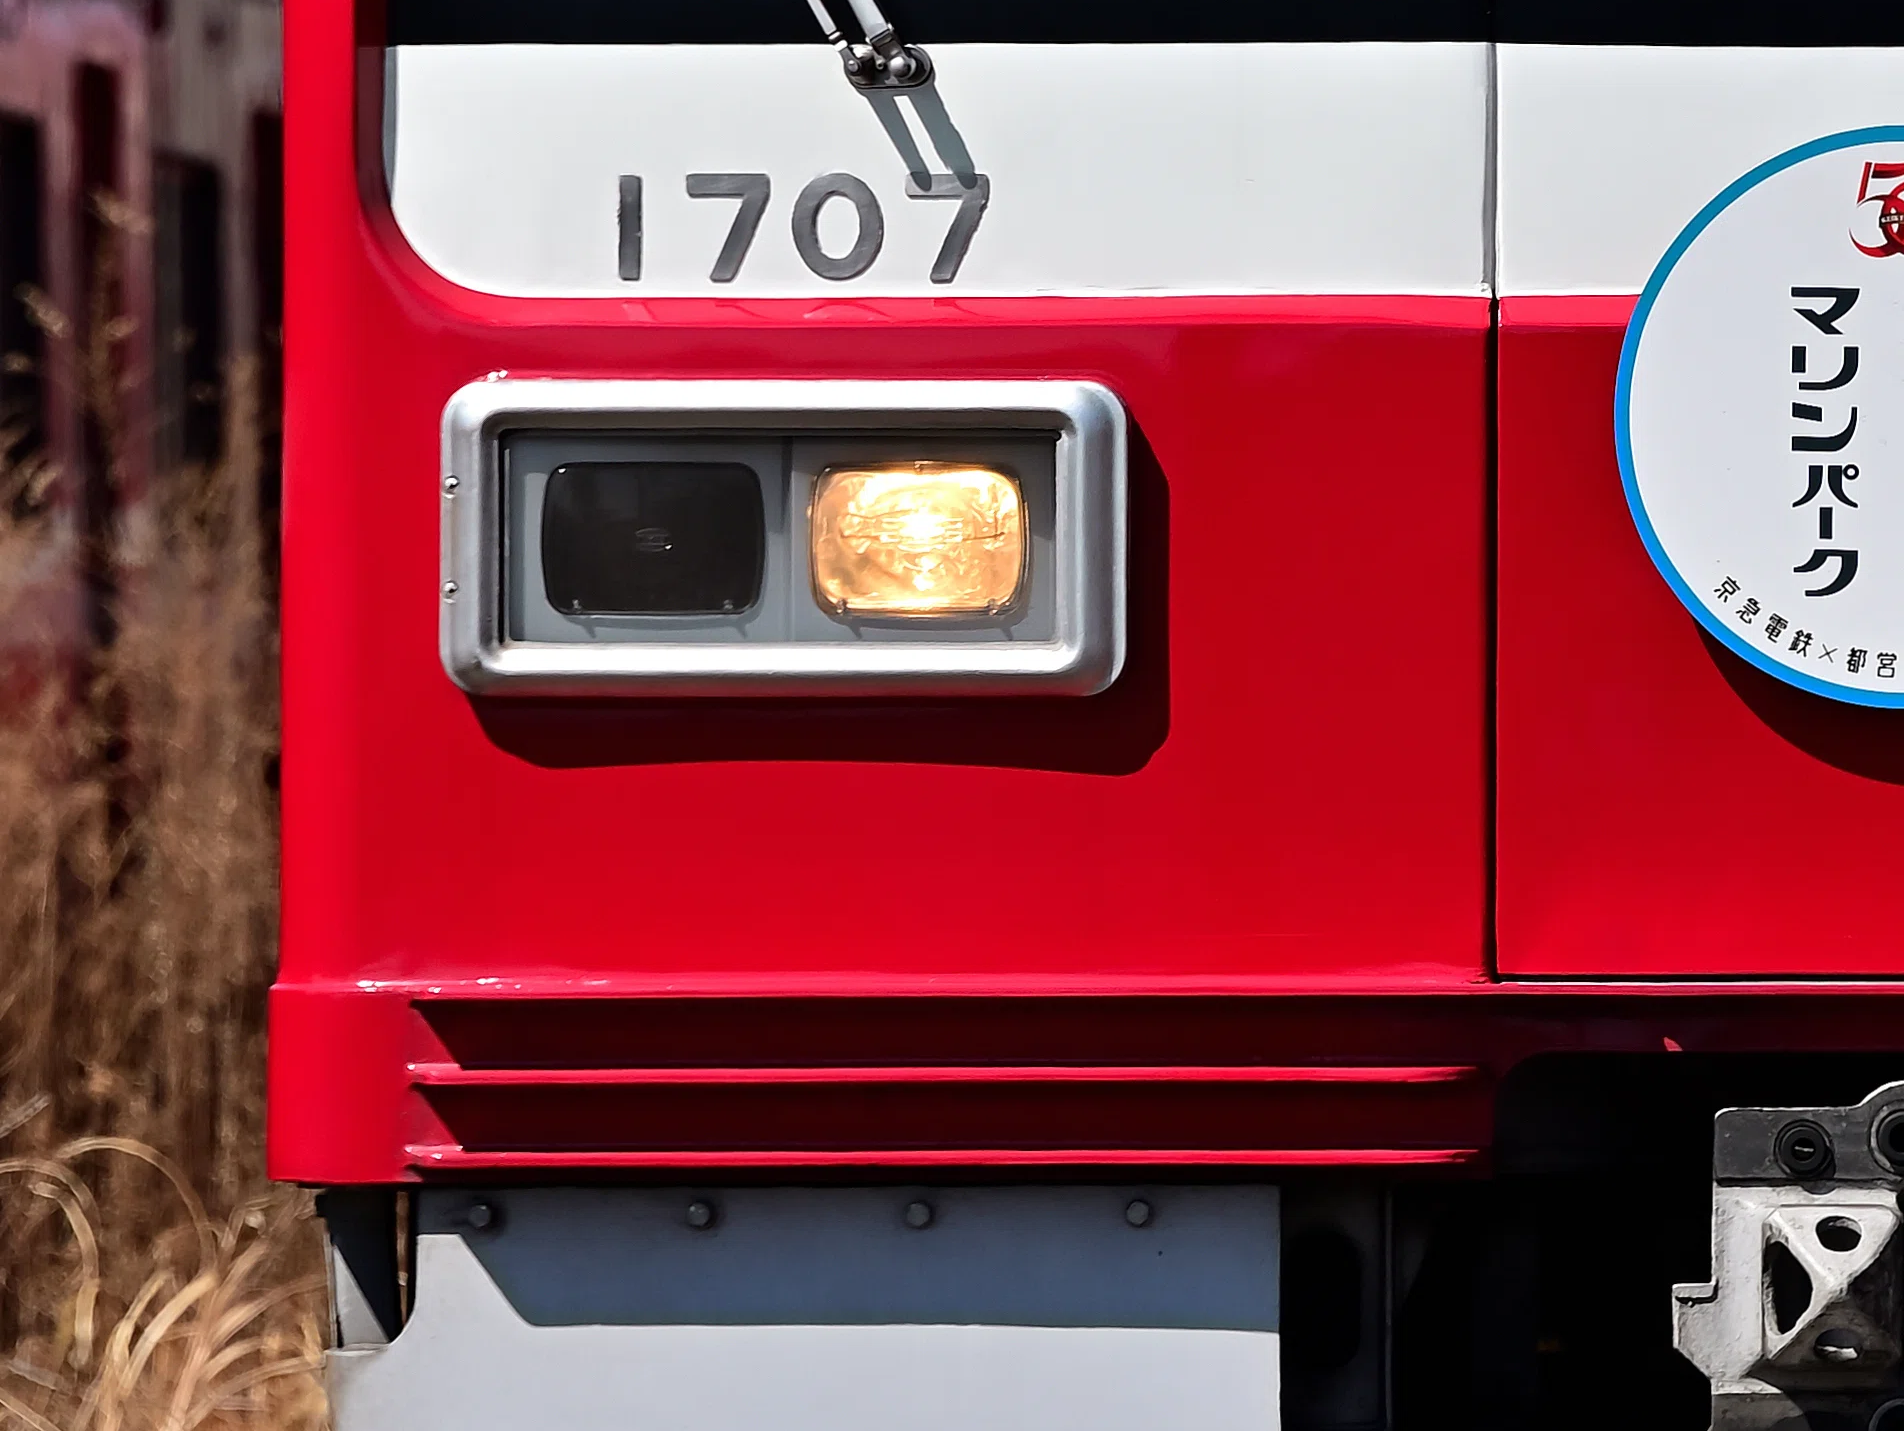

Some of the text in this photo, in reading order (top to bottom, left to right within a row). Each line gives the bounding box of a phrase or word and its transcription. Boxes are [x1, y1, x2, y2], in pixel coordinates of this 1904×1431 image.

[617, 172, 991, 283] 1707
[1791, 287, 1860, 597] マリンパーク
